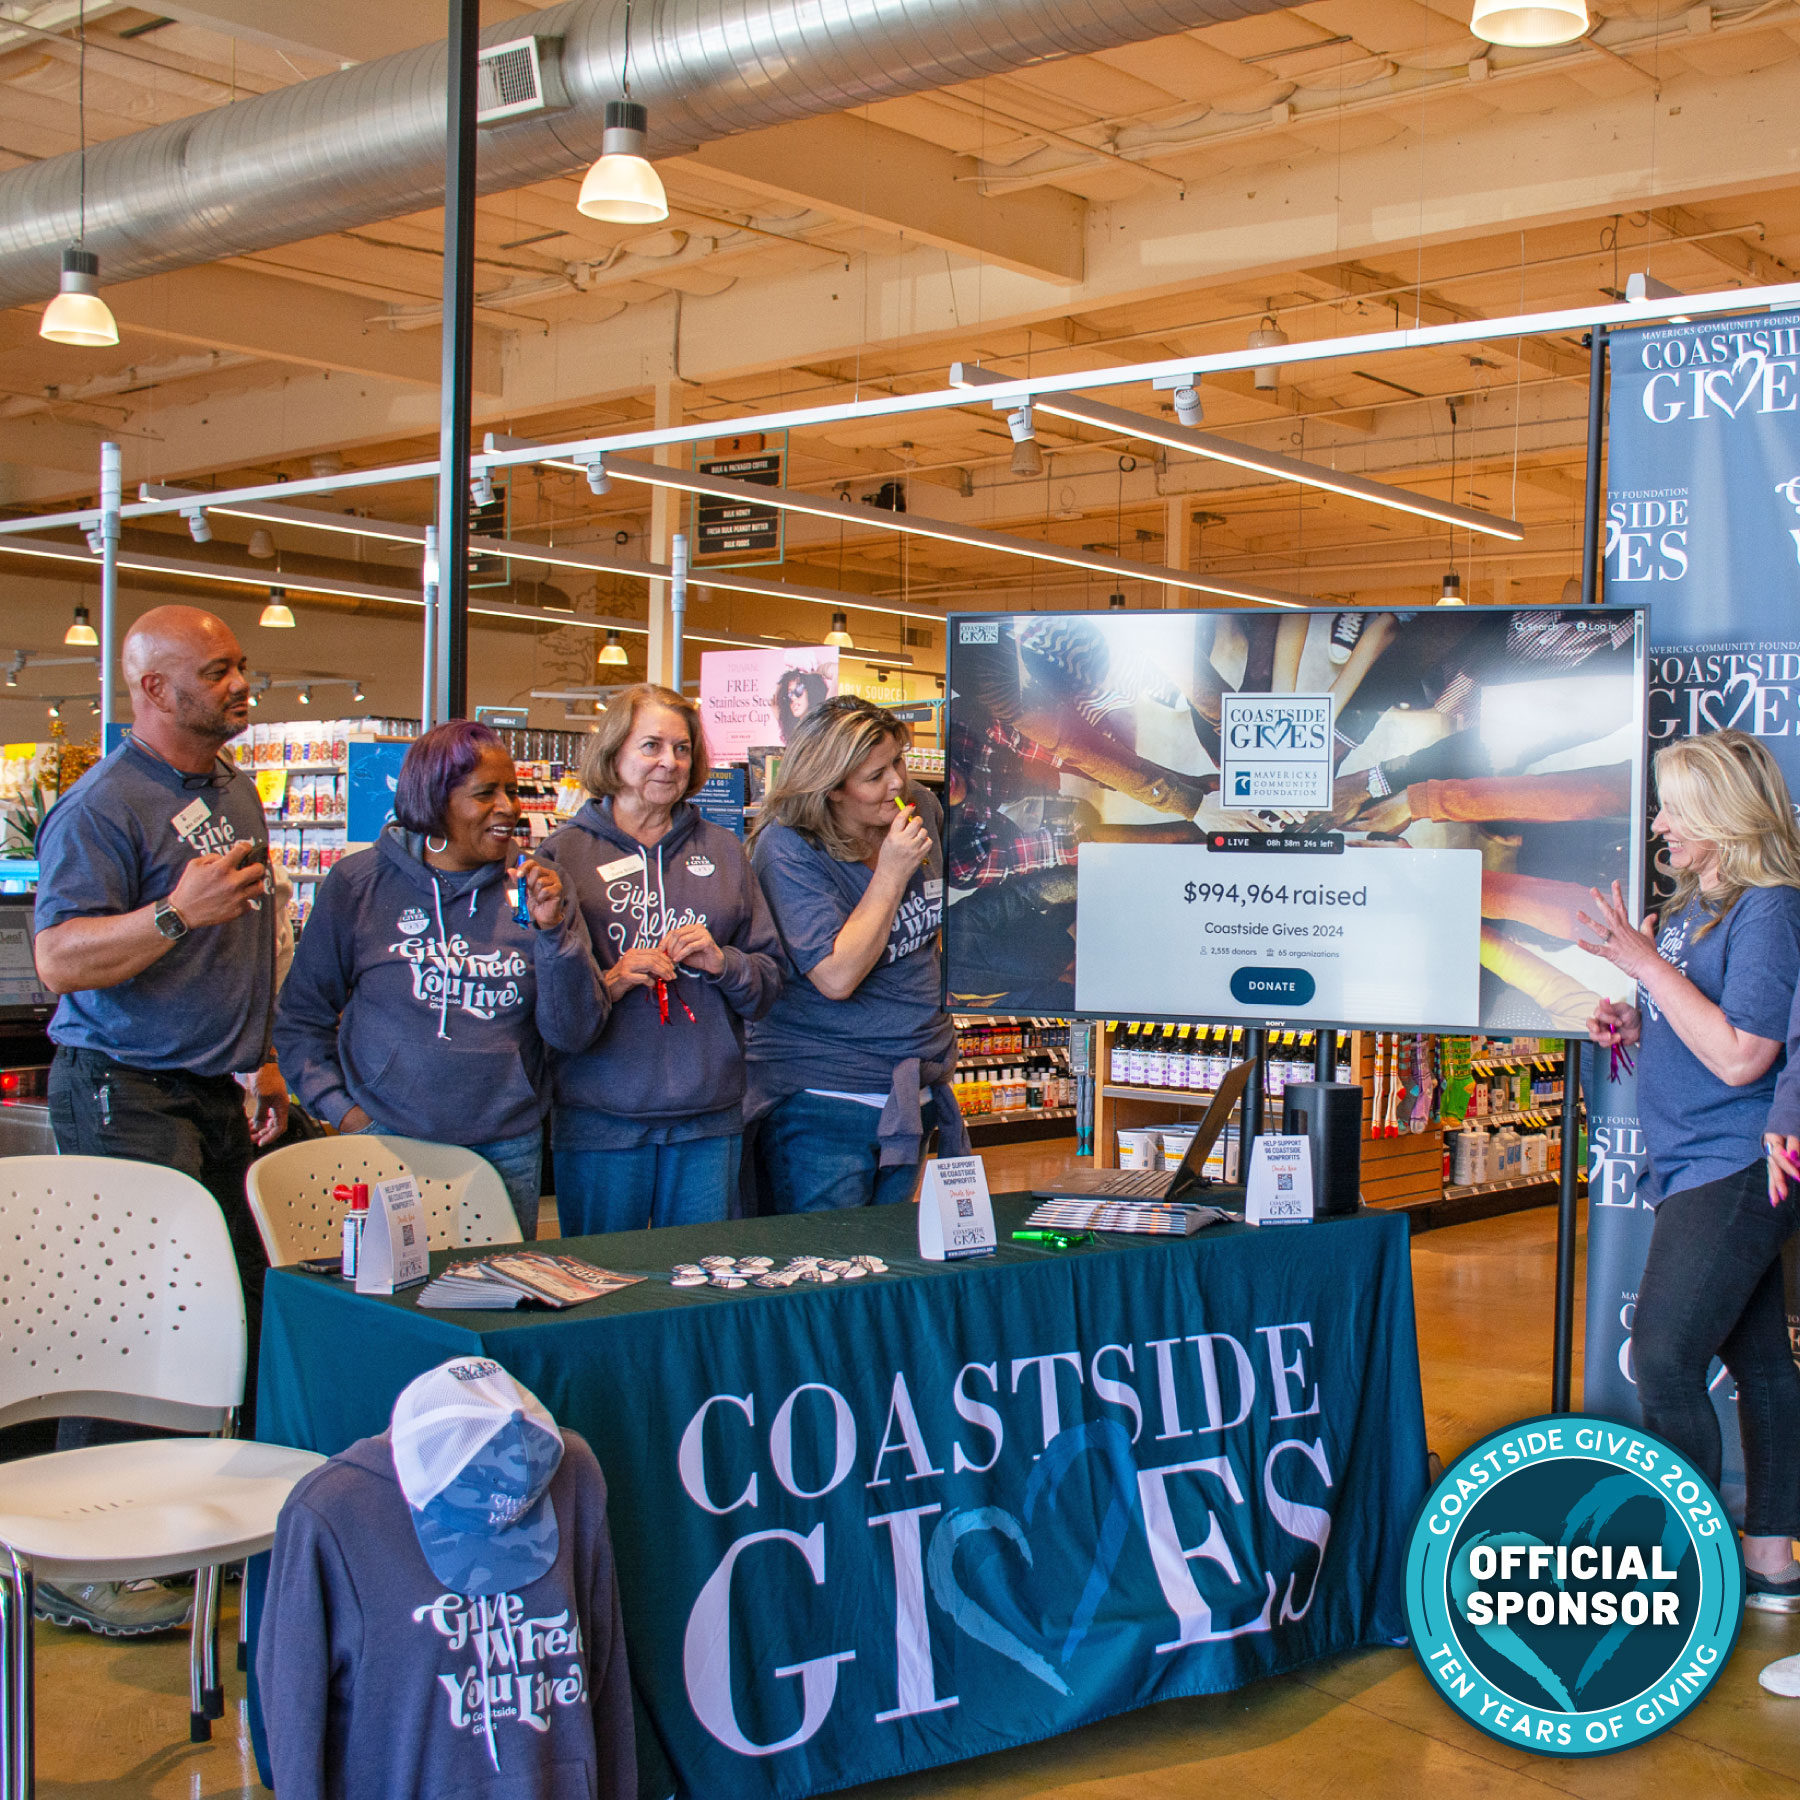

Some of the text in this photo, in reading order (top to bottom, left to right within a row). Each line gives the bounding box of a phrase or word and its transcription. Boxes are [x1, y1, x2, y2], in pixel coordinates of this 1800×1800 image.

[1642, 326, 1695, 341] MAVERICKS
[1697, 319, 1761, 335] COMMUNITY
[1622, 487, 1689, 500] FOUNDATION
[1589, 623, 1606, 633] Log
[1696, 641, 1756, 653] COMMUNITY
[727, 679, 759, 693] FREE
[709, 695, 750, 709] Stainless
[714, 710, 770, 727] Shaker Cup
[1230, 709, 1326, 723] COASTSIDE
[1254, 771, 1317, 779] MAVERICKS
[1227, 838, 1334, 848] LIVE 08h 38m 24s left
[606, 881, 660, 913] Give
[1183, 881, 1367, 908] $994,964 raised
[1204, 922, 1344, 938] Coastside Gives 2024
[388, 933, 470, 966] Give
[1210, 947, 1340, 960] 2,555 donors 65 organizations
[429, 949, 527, 979] Where
[408, 963, 462, 1001] You
[1248, 981, 1296, 992] DONATE
[937, 1160, 976, 1171] HELP SUPPORT
[947, 1168, 976, 1177] COASTSIDE
[943, 1176, 977, 1186] NONPROFITS
[677, 1320, 1321, 1516] COASTSIDE
[412, 1592, 525, 1650] Give
[437, 1665, 513, 1728] You
